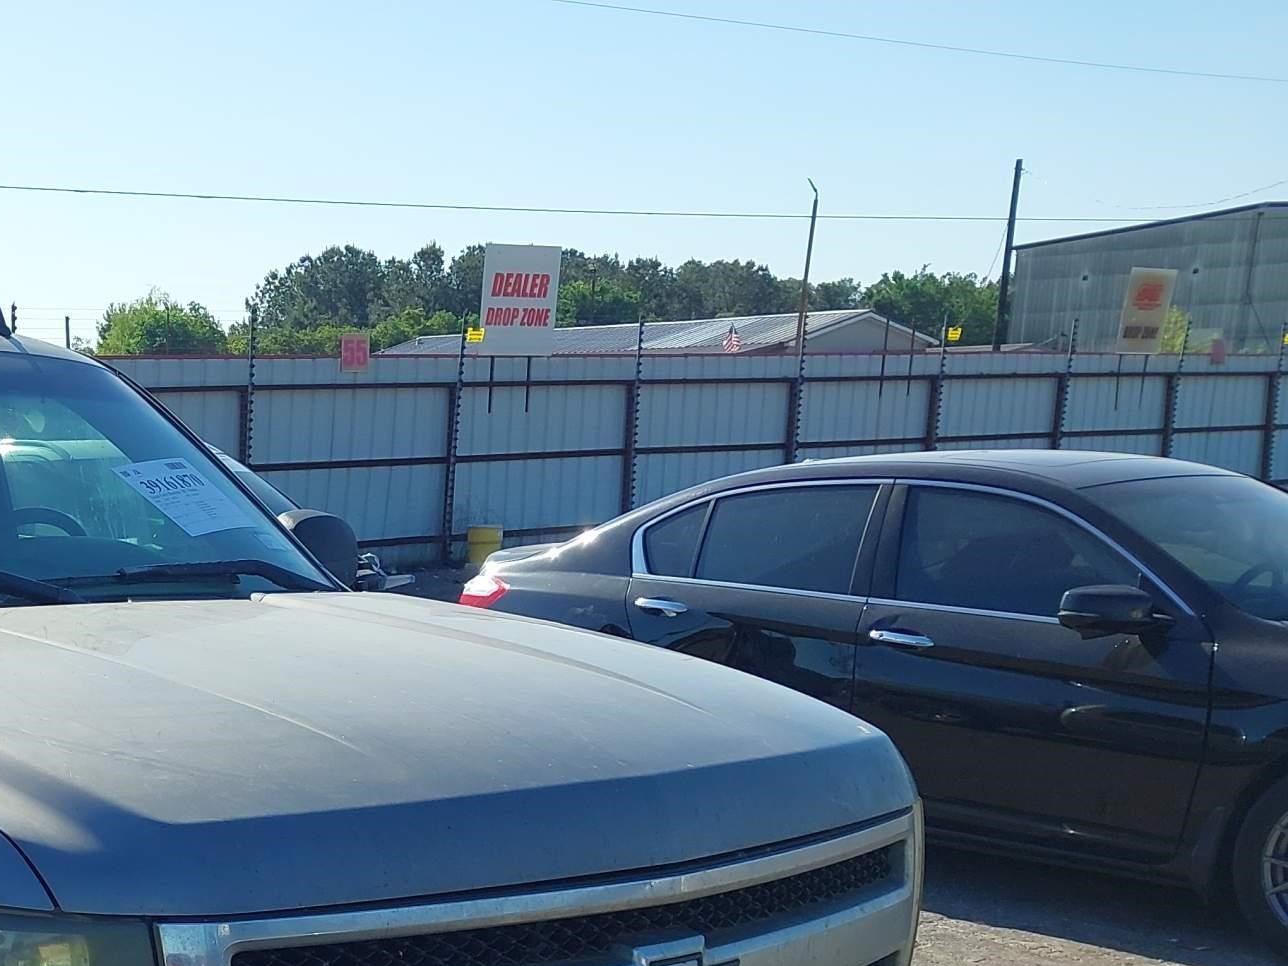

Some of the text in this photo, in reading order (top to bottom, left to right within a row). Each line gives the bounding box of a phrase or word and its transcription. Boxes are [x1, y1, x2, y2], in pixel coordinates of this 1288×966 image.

[491, 272, 550, 298] DEALER
[485, 307, 551, 327] DROP ZONE
[344, 339, 368, 366] 55
[140, 473, 205, 494] 39161870
